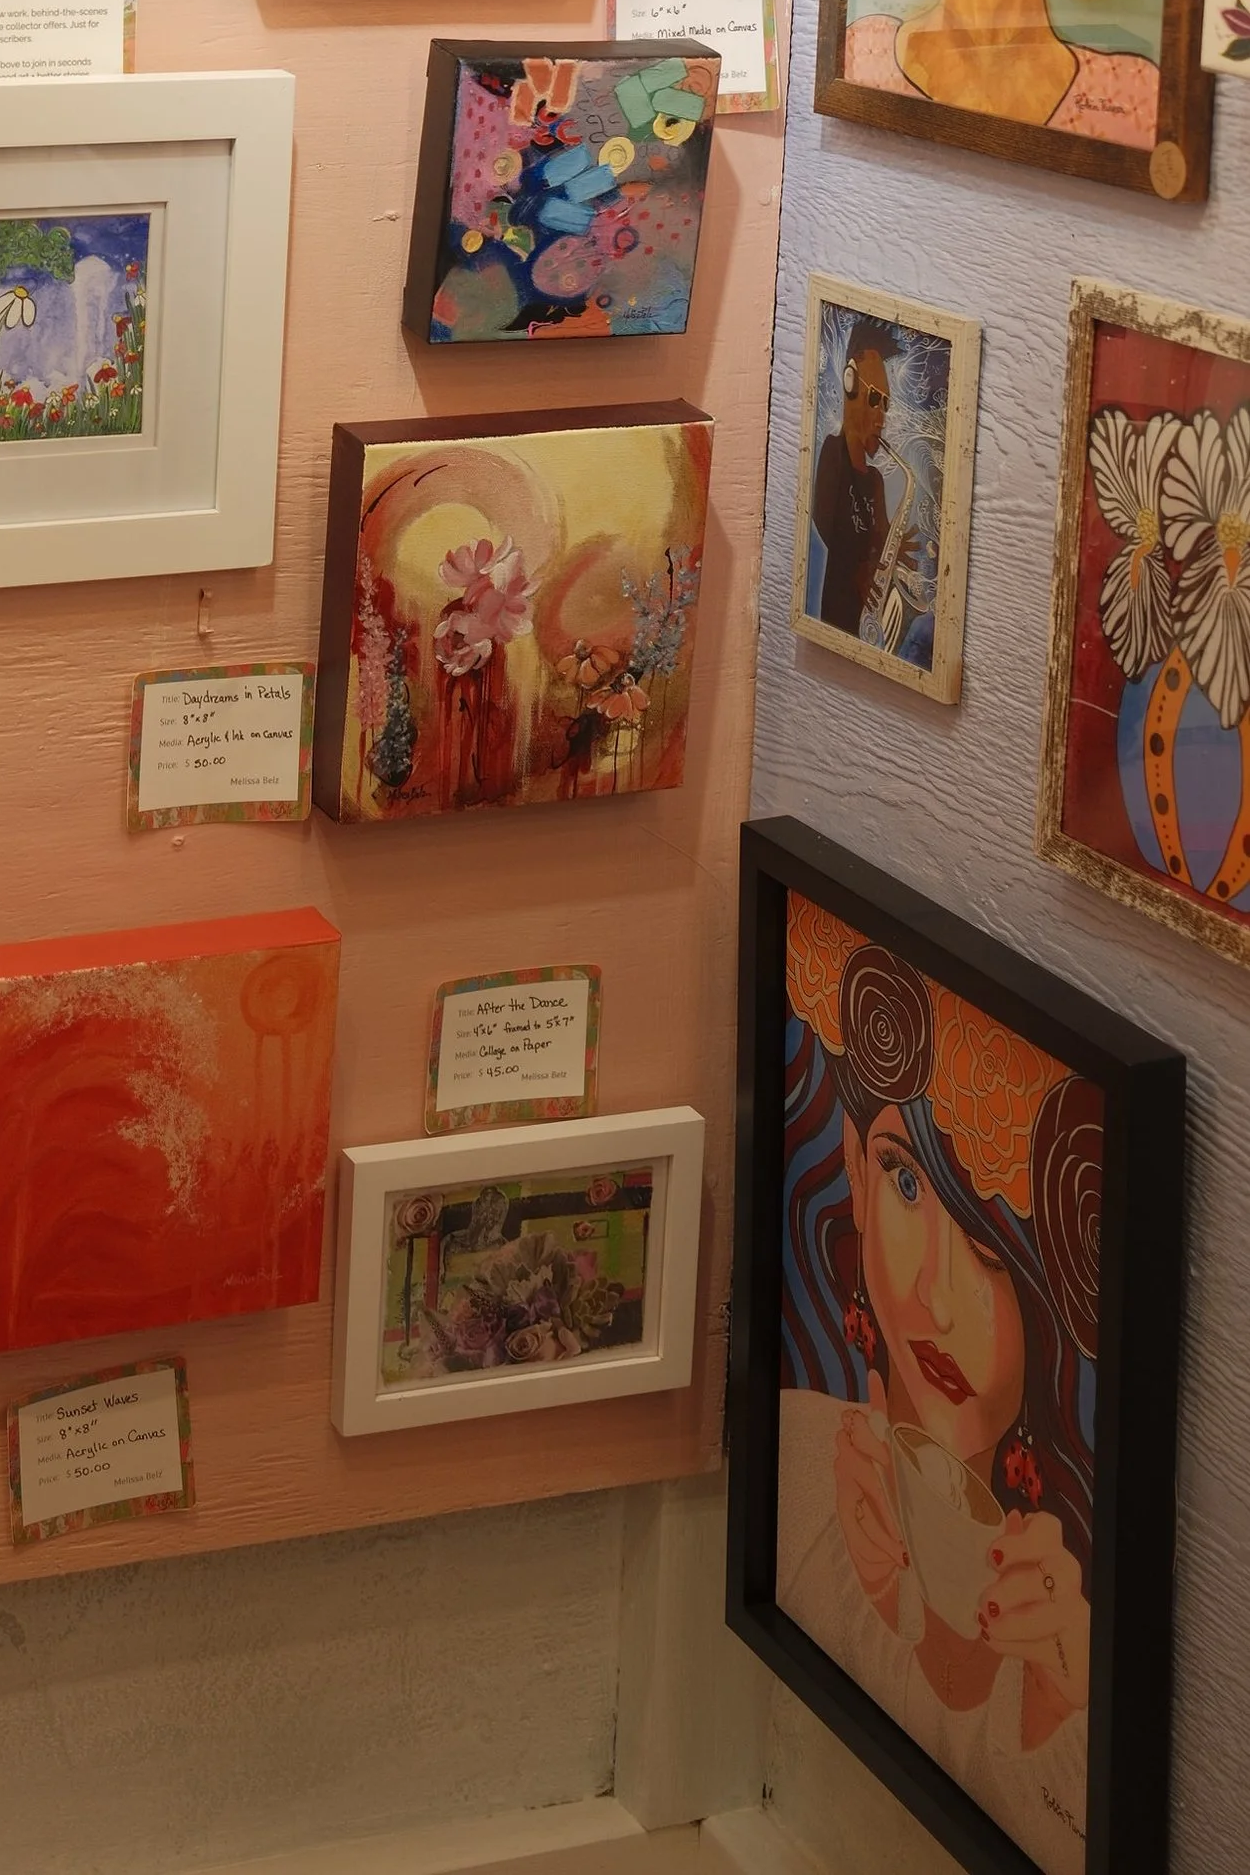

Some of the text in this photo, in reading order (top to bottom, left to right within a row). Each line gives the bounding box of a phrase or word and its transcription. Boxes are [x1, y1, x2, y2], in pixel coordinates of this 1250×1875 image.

[31, 8, 107, 17] behind-the-scenes
[6, 21, 42, 30] collector
[70, 20, 89, 29] Just
[89, 20, 99, 28] for
[658, 26, 686, 38] Mixed
[689, 25, 712, 35] Media
[728, 21, 757, 32] Canvas
[22, 59, 30, 68] to
[31, 59, 47, 69] join
[48, 59, 56, 67] in
[57, 57, 92, 67] seconds
[182, 690, 239, 708] Daydreams
[244, 686, 253, 699] in
[258, 686, 291, 699] Petals
[187, 732, 221, 748] Acrylic
[232, 730, 244, 741] Ink
[251, 731, 261, 739] on
[263, 730, 293, 739] Canvas
[230, 776, 279, 786] Melissa Belz
[477, 1000, 505, 1015] After
[508, 997, 525, 1012] the
[529, 996, 568, 1009] Dance
[504, 1021, 531, 1033] framed
[523, 1039, 552, 1053] Paper
[522, 1072, 549, 1081] Melissa
[57, 1392, 139, 1420] Sunset Waves
[66, 1429, 166, 1460] Acrylic on Canvas
[114, 1475, 143, 1487] Melissa
